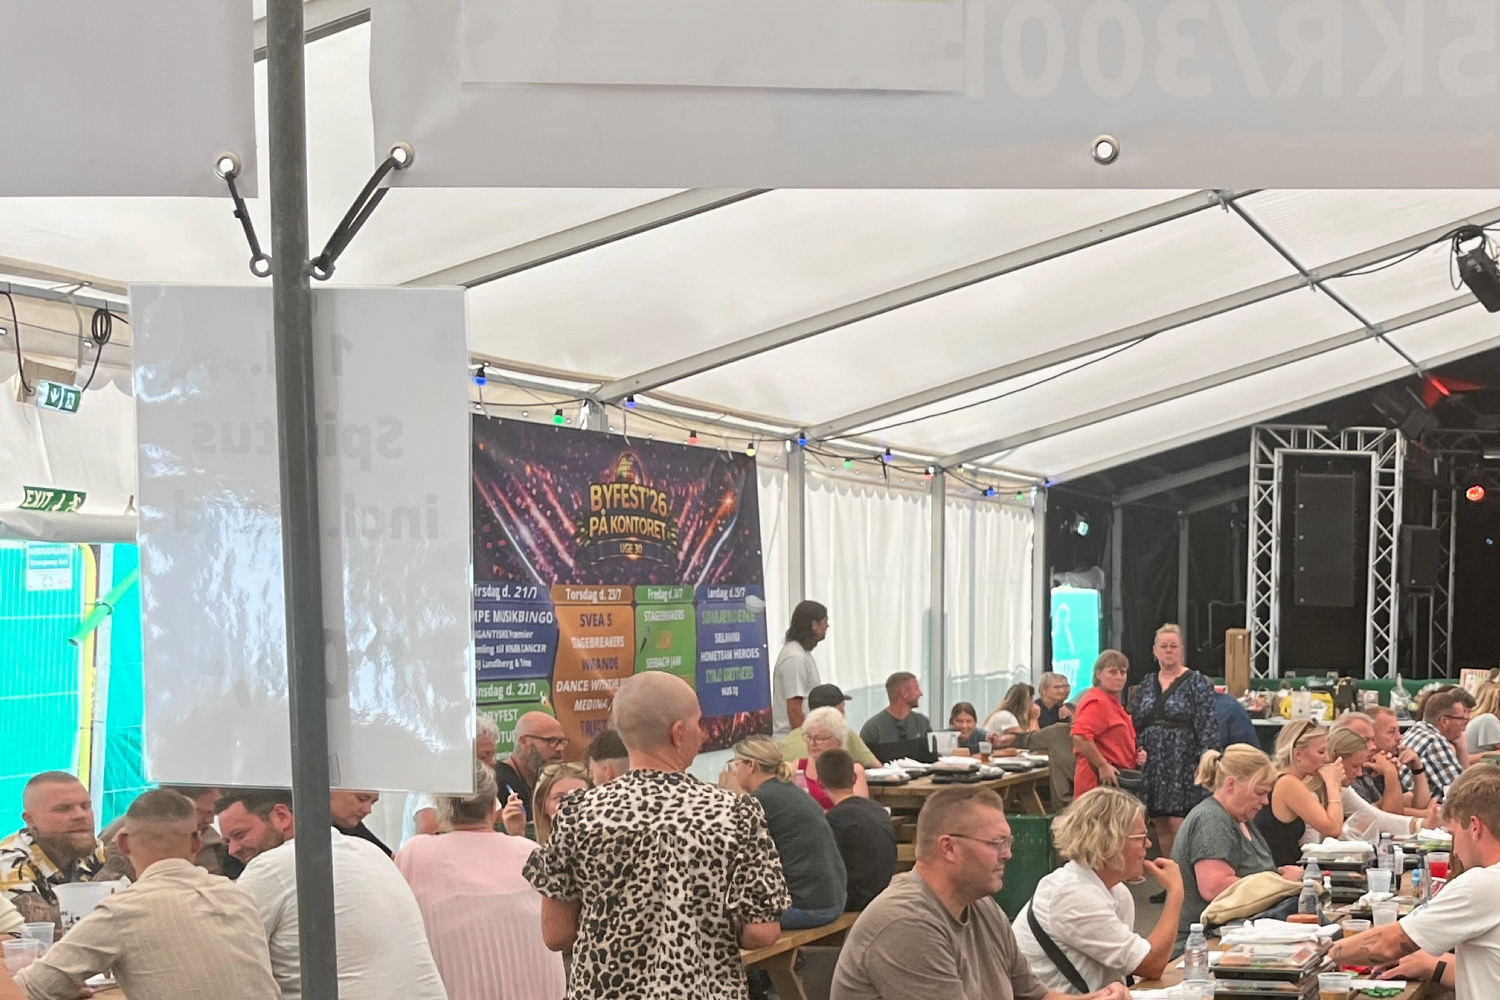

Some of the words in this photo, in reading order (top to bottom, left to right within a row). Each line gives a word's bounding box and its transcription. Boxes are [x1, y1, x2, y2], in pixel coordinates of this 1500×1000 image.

[21, 490, 54, 510] EXIT
[590, 484, 667, 517] BYFEST'26
[589, 508, 609, 537] PÅ
[610, 515, 667, 540] KONTORET
[474, 584, 500, 601] irsdag
[566, 588, 597, 603] Torsdag
[648, 588, 669, 602] Fredag
[493, 610, 553, 624] MUSIKBINGO
[580, 613, 605, 627] SVEA
[606, 613, 612, 626] S
[556, 681, 589, 693] DANCE
